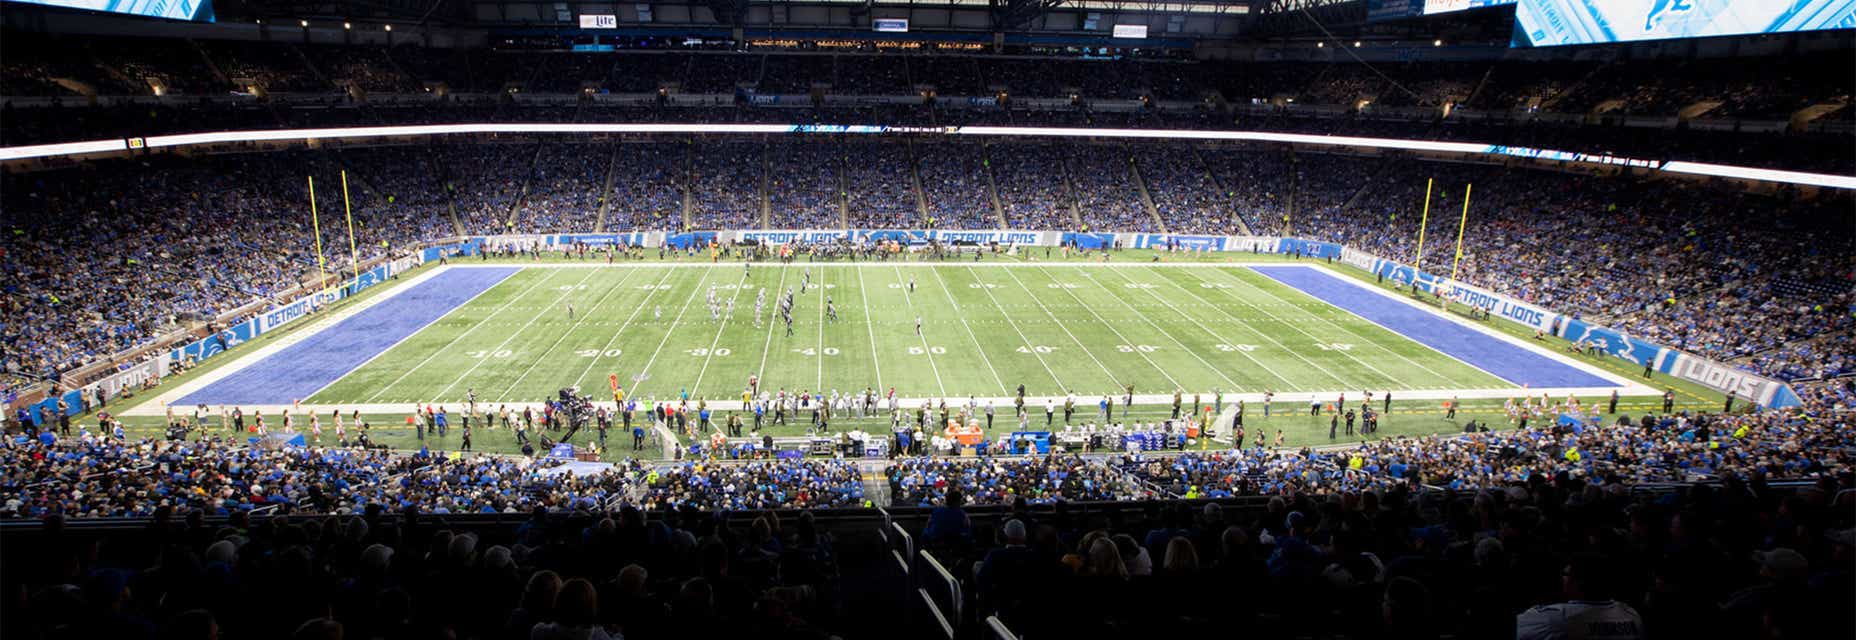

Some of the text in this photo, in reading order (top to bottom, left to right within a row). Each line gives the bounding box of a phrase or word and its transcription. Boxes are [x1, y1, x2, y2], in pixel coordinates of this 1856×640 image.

[596, 15, 614, 26] Lite
[999, 232, 1037, 244] LIONS
[267, 300, 307, 328] DETROIT
[1502, 302, 1545, 327] LIONS
[801, 346, 841, 356] 40
[907, 345, 947, 355] 50
[1015, 344, 1053, 354] 40
[1683, 358, 1762, 401] LIONS
